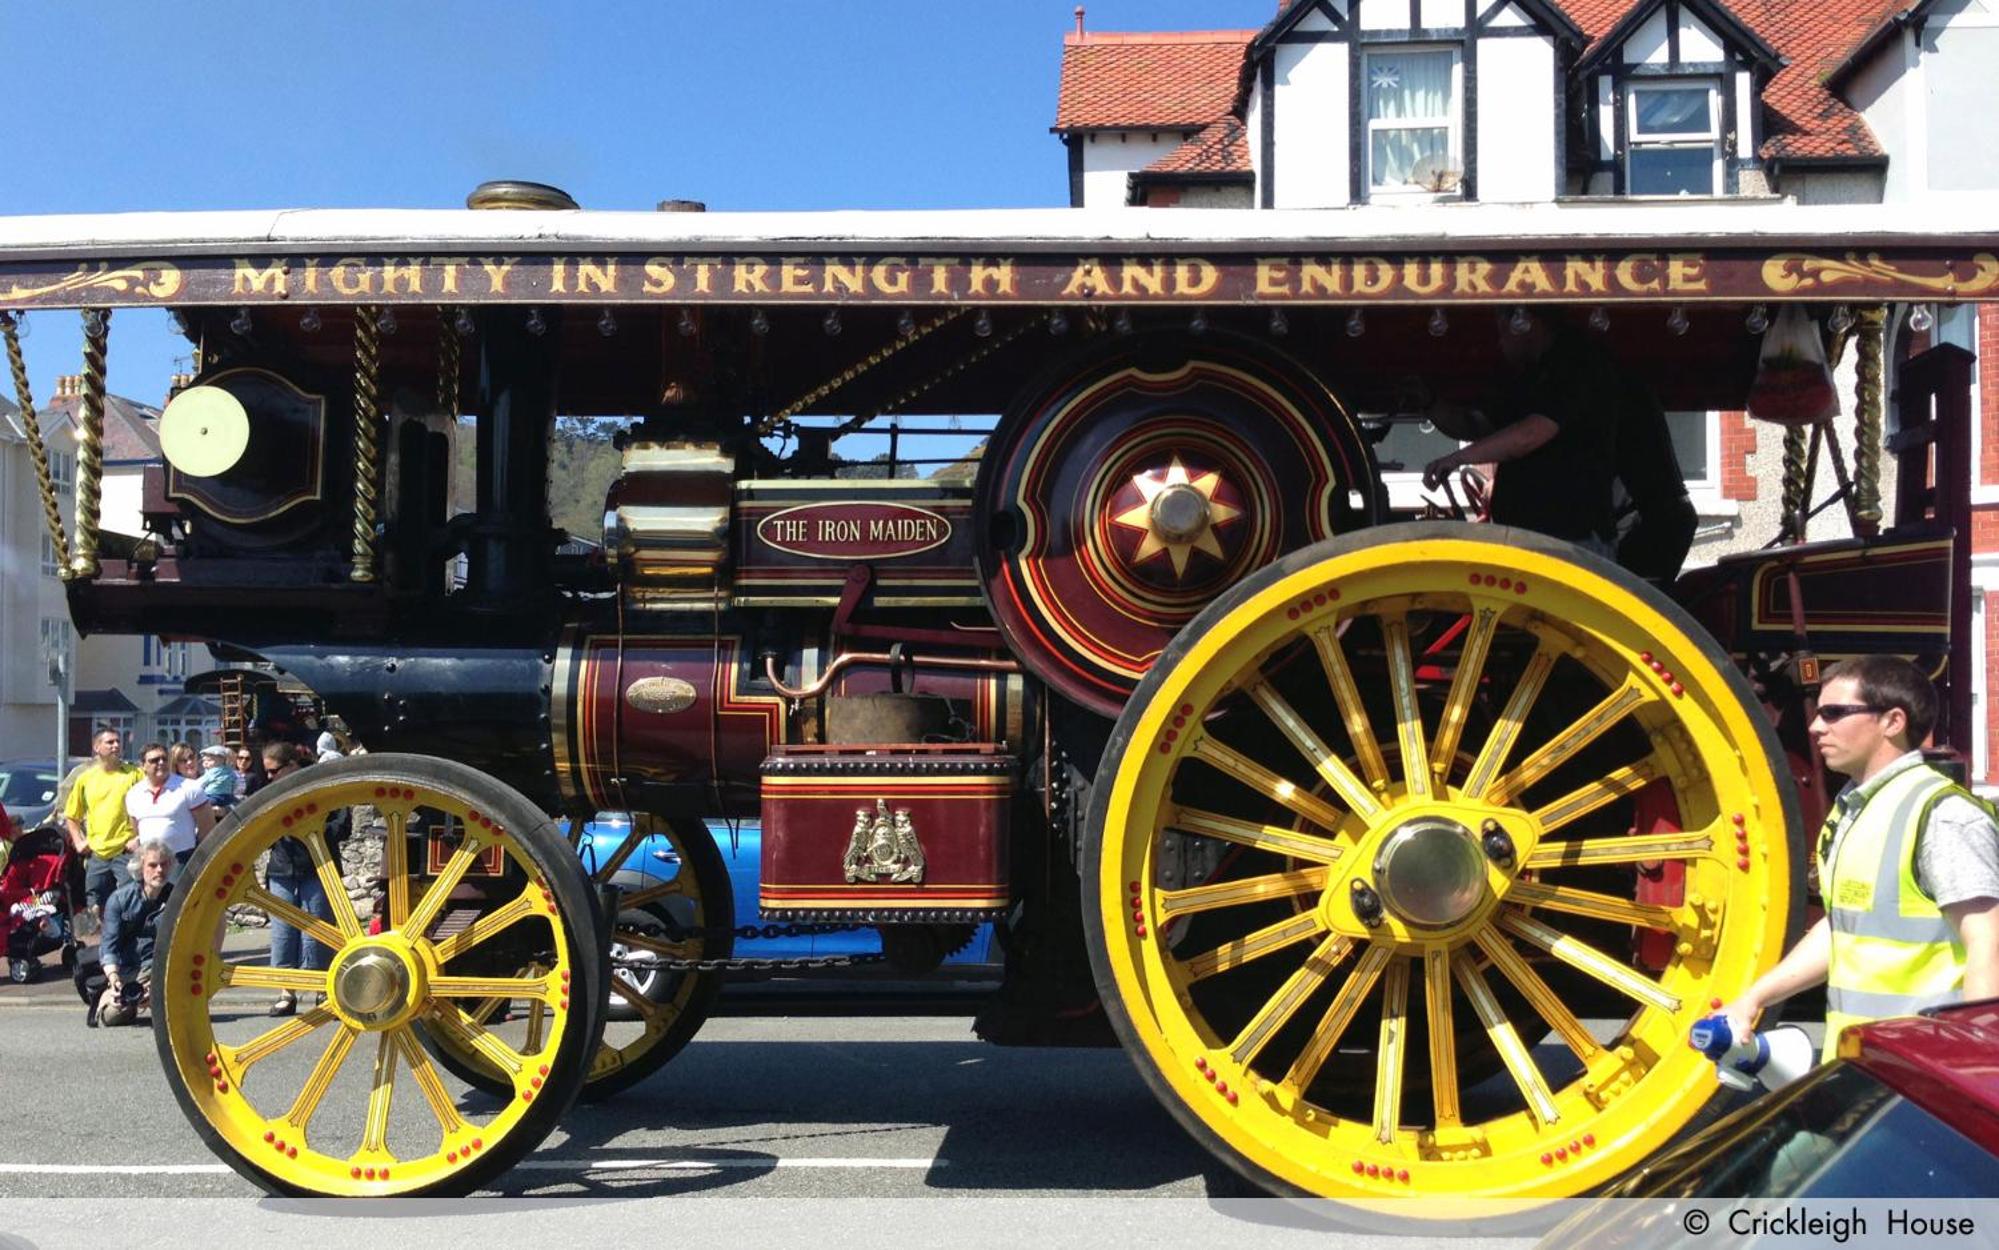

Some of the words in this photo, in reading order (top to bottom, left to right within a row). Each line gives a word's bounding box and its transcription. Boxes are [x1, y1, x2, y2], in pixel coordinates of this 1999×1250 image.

[231, 256, 522, 295] MIGHTY
[549, 256, 620, 293] IN
[642, 256, 1015, 295] STRENGTH
[1061, 257, 1219, 296] AND
[1254, 253, 1708, 295] ENDURANCE
[772, 519, 809, 543] THE
[817, 519, 861, 542] IRON
[868, 518, 939, 541] MAIDEN
